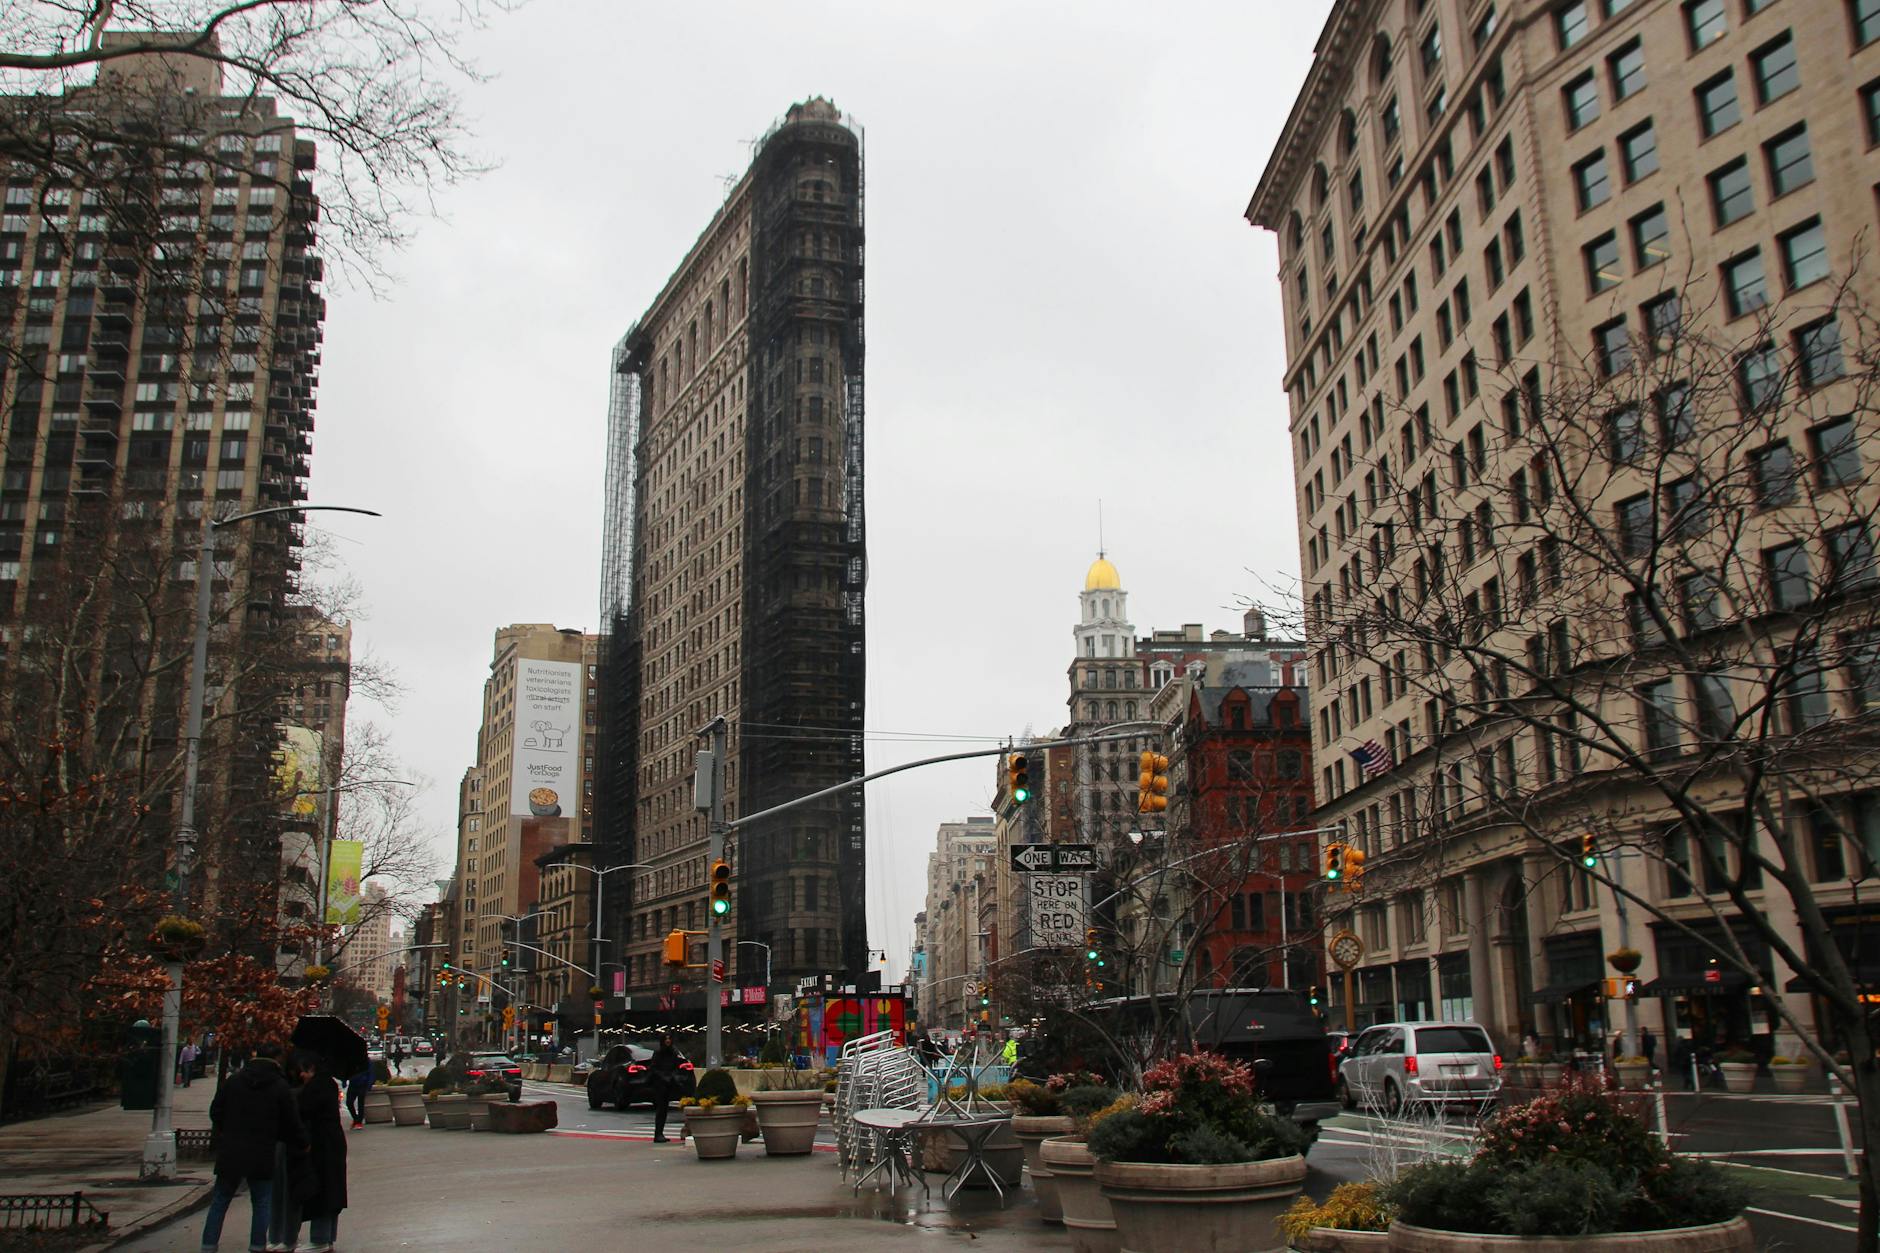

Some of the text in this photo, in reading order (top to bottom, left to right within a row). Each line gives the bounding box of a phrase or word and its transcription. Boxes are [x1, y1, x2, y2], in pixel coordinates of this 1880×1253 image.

[527, 667, 572, 678] Nutritionists
[526, 677, 572, 687] veterinarians
[526, 685, 572, 695] toxicologists
[1024, 853, 1085, 864] ONE WAY
[1034, 881, 1078, 897] STOP
[1037, 901, 1061, 910] HERE
[1040, 913, 1074, 929] RED
